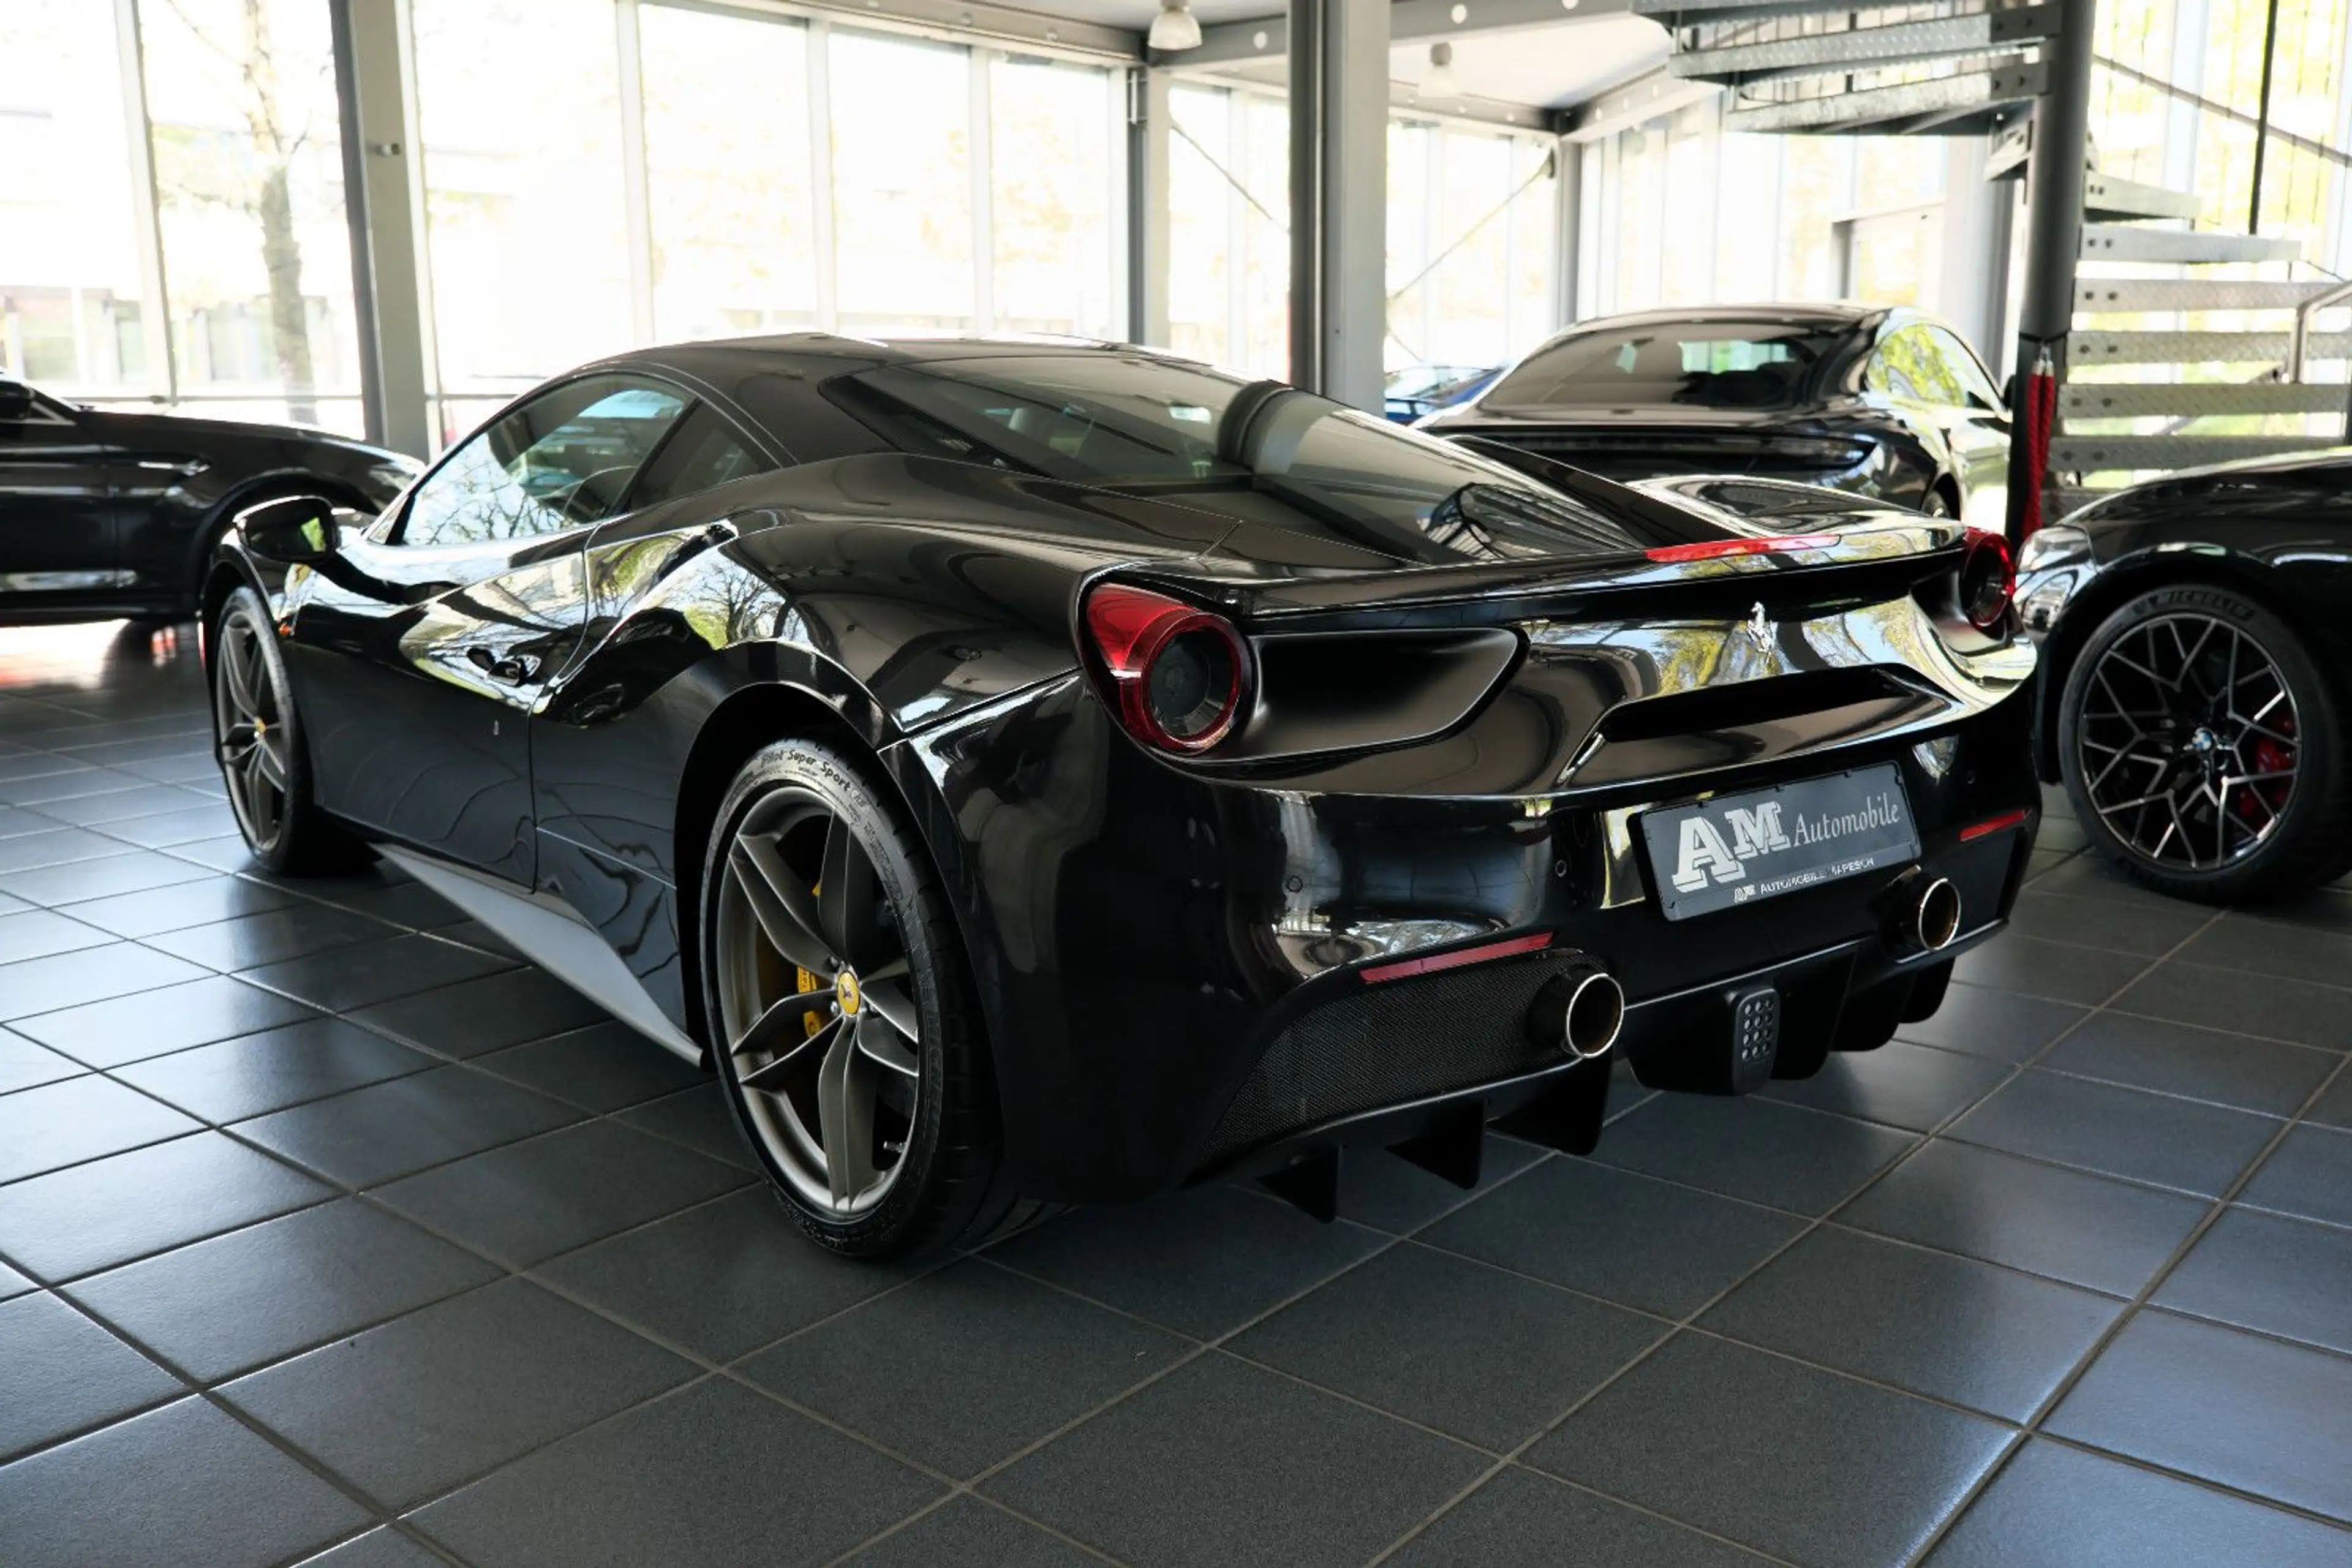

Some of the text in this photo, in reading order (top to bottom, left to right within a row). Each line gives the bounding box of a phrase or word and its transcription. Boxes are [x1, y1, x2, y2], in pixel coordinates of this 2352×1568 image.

[788, 749, 816, 765] Super
[820, 761, 851, 791] Sport
[1672, 792, 1901, 892] AM Automobile
